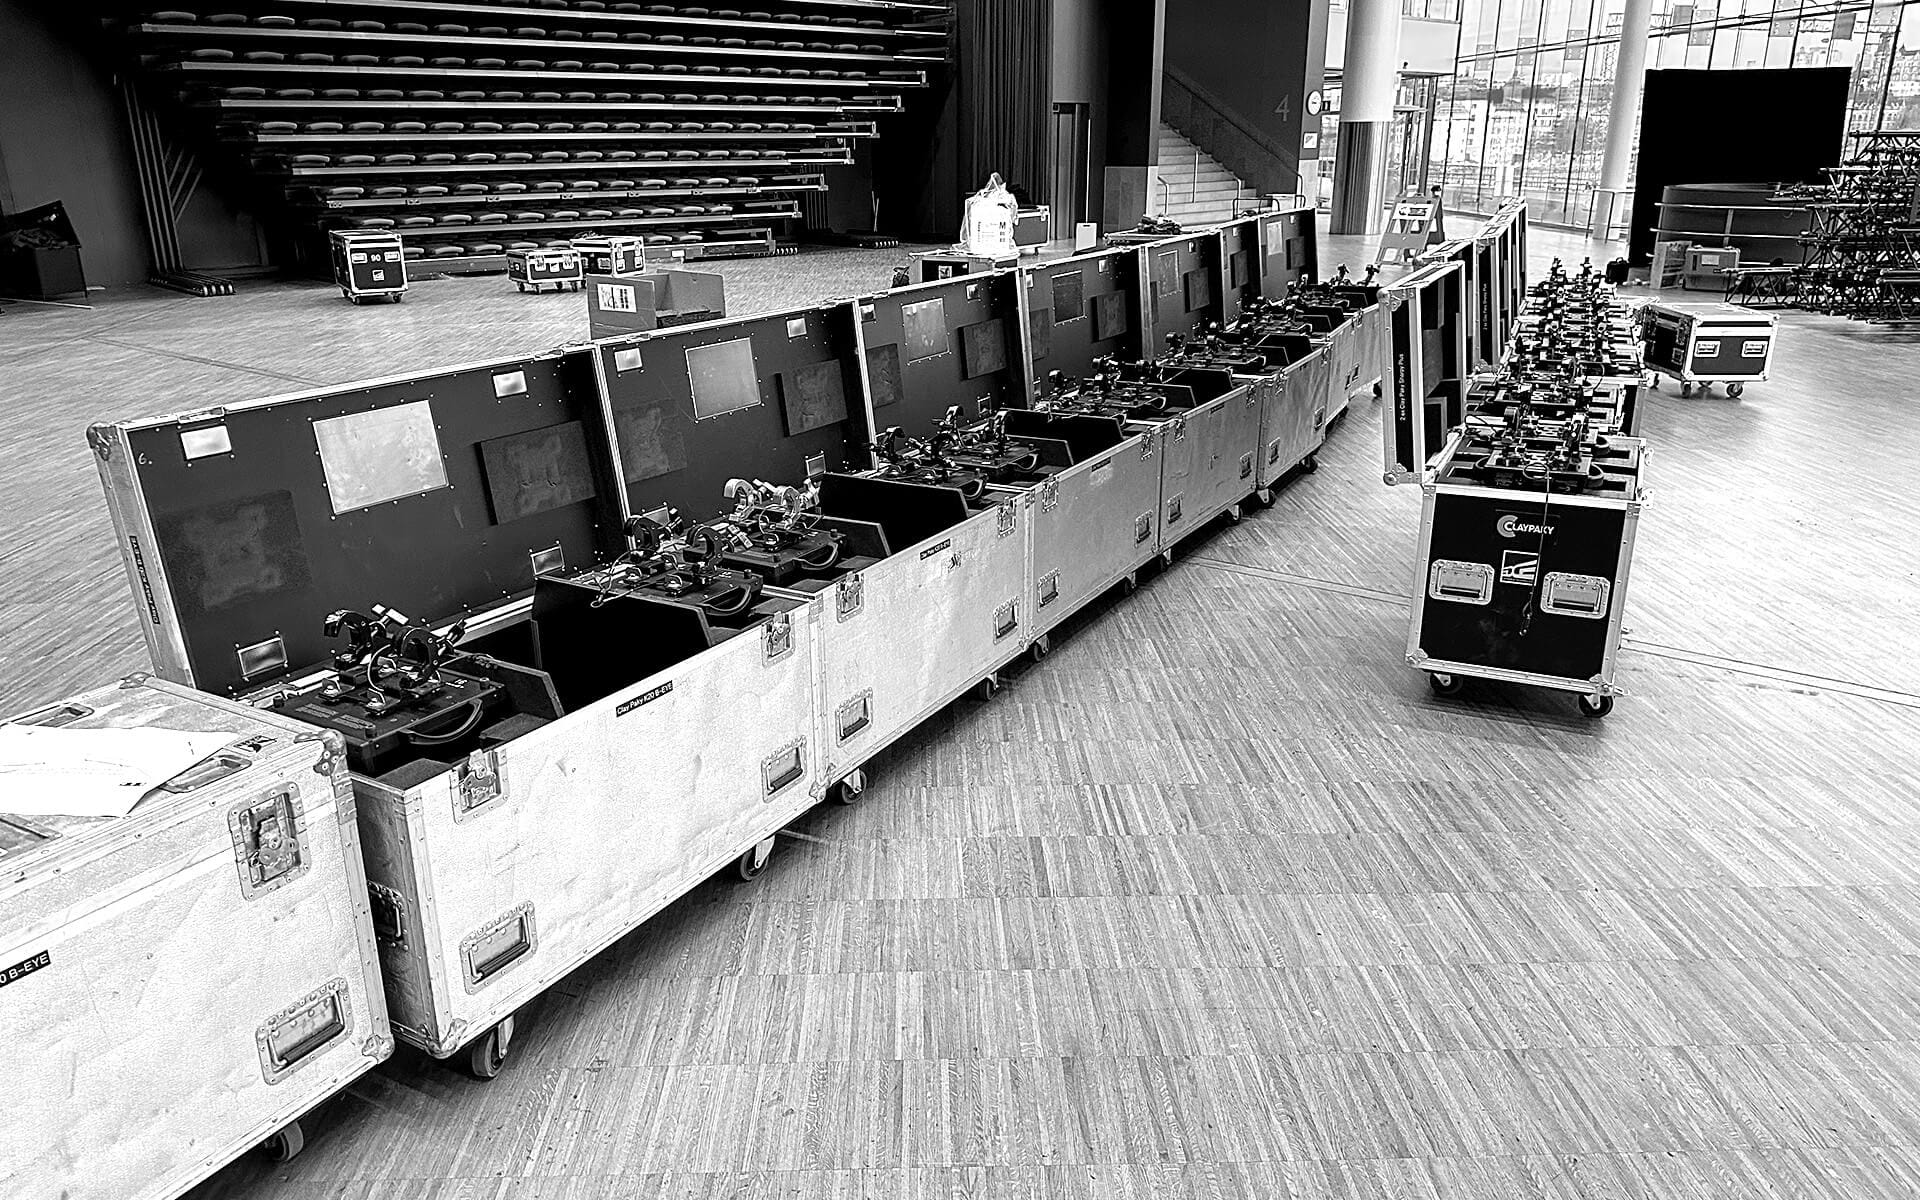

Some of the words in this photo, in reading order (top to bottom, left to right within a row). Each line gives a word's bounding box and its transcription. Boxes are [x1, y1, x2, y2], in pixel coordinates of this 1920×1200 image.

[1275, 94, 1290, 122] 4
[370, 253, 381, 262] 90
[1503, 520, 1555, 535] CLAYPAKY
[8, 953, 50, 979] B-EYE
